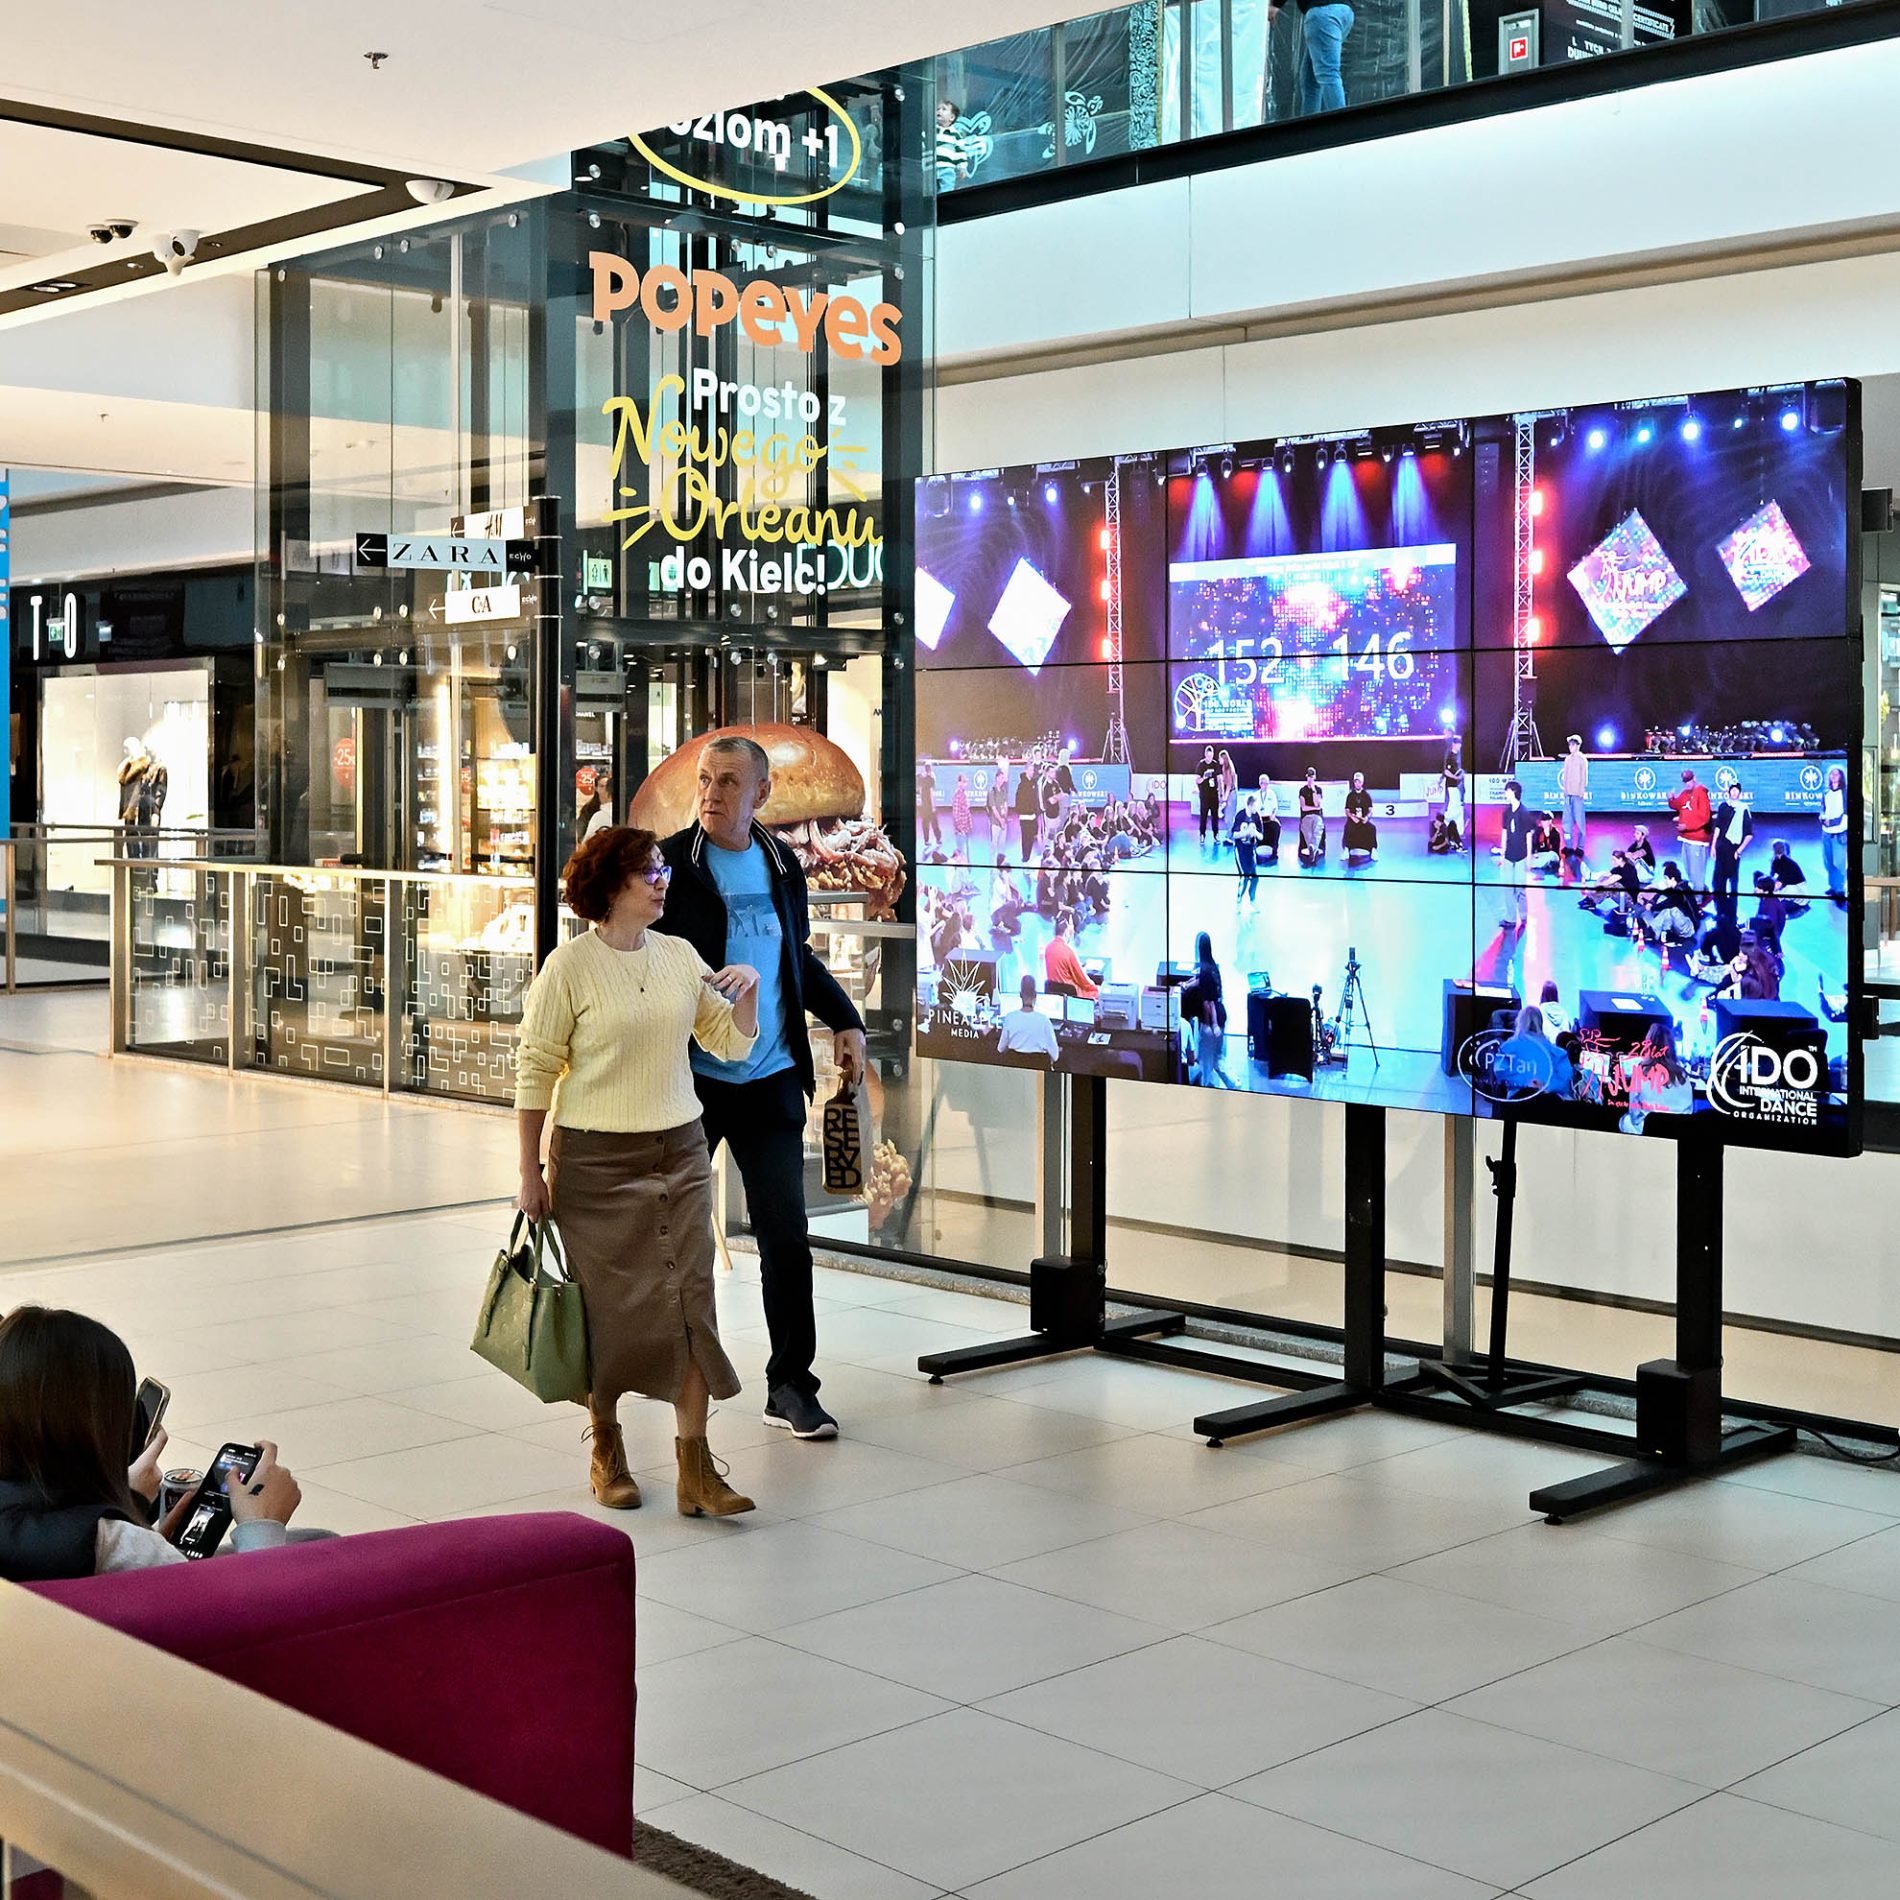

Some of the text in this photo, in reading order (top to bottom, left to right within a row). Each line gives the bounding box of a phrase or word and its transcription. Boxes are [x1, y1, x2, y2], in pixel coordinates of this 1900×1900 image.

[802, 124, 838, 169] +1
[693, 367, 847, 426] Prosto z
[601, 373, 828, 498] Nowego
[660, 466, 883, 547] Orleanu
[392, 542, 501, 565] ZARA
[661, 545, 826, 596] do Kielc!
[1207, 630, 1415, 685] 152 146
[1621, 791, 1668, 800] BINKOWSK
[1385, 804, 1396, 816] 3
[950, 1028, 980, 1039] MEDIA
[1610, 1063, 1670, 1097] JUMP
[1739, 1086, 1818, 1102] INTERNATIONAL
[1733, 1110, 1818, 1126] ORGANIZATION
[1760, 1098, 1818, 1117] DANCE
